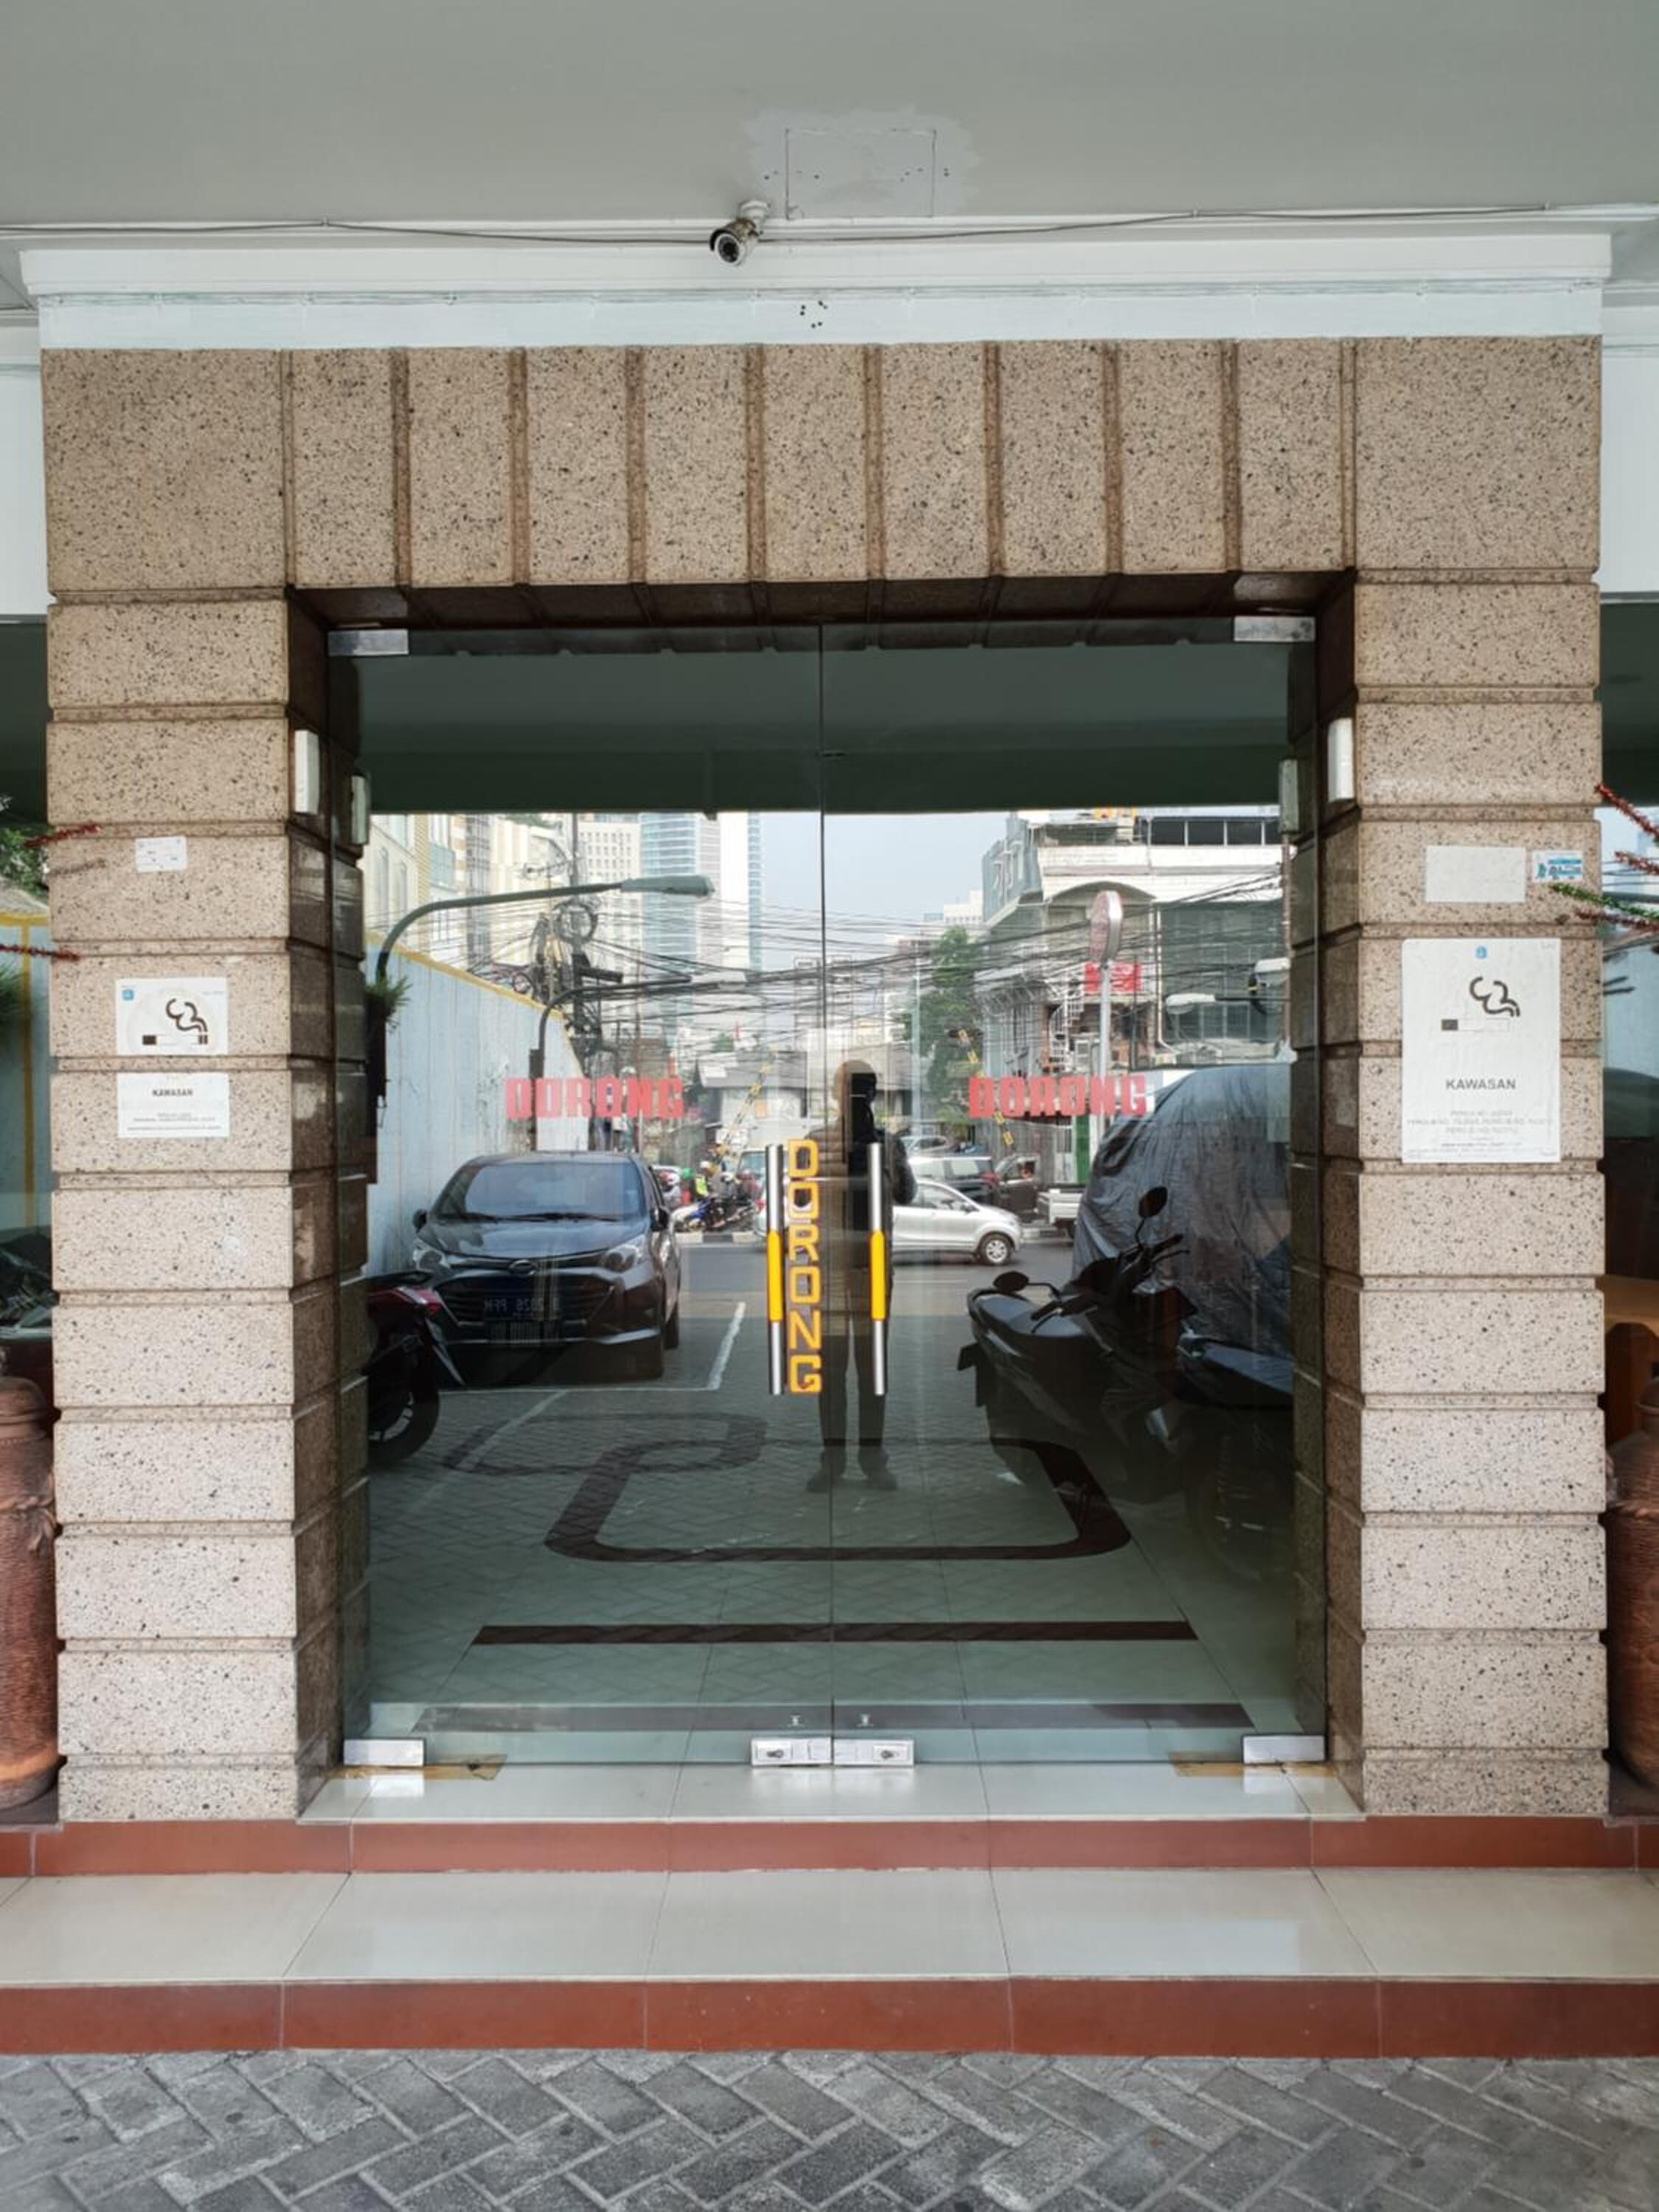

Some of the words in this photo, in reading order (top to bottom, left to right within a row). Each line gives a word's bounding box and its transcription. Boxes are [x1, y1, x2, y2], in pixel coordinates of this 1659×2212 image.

[505, 1077, 684, 1119] DORONG
[968, 1075, 1147, 1118] DORONG
[1445, 1078, 1517, 1091] KAWASAN
[787, 1138, 823, 1394] DORONG
